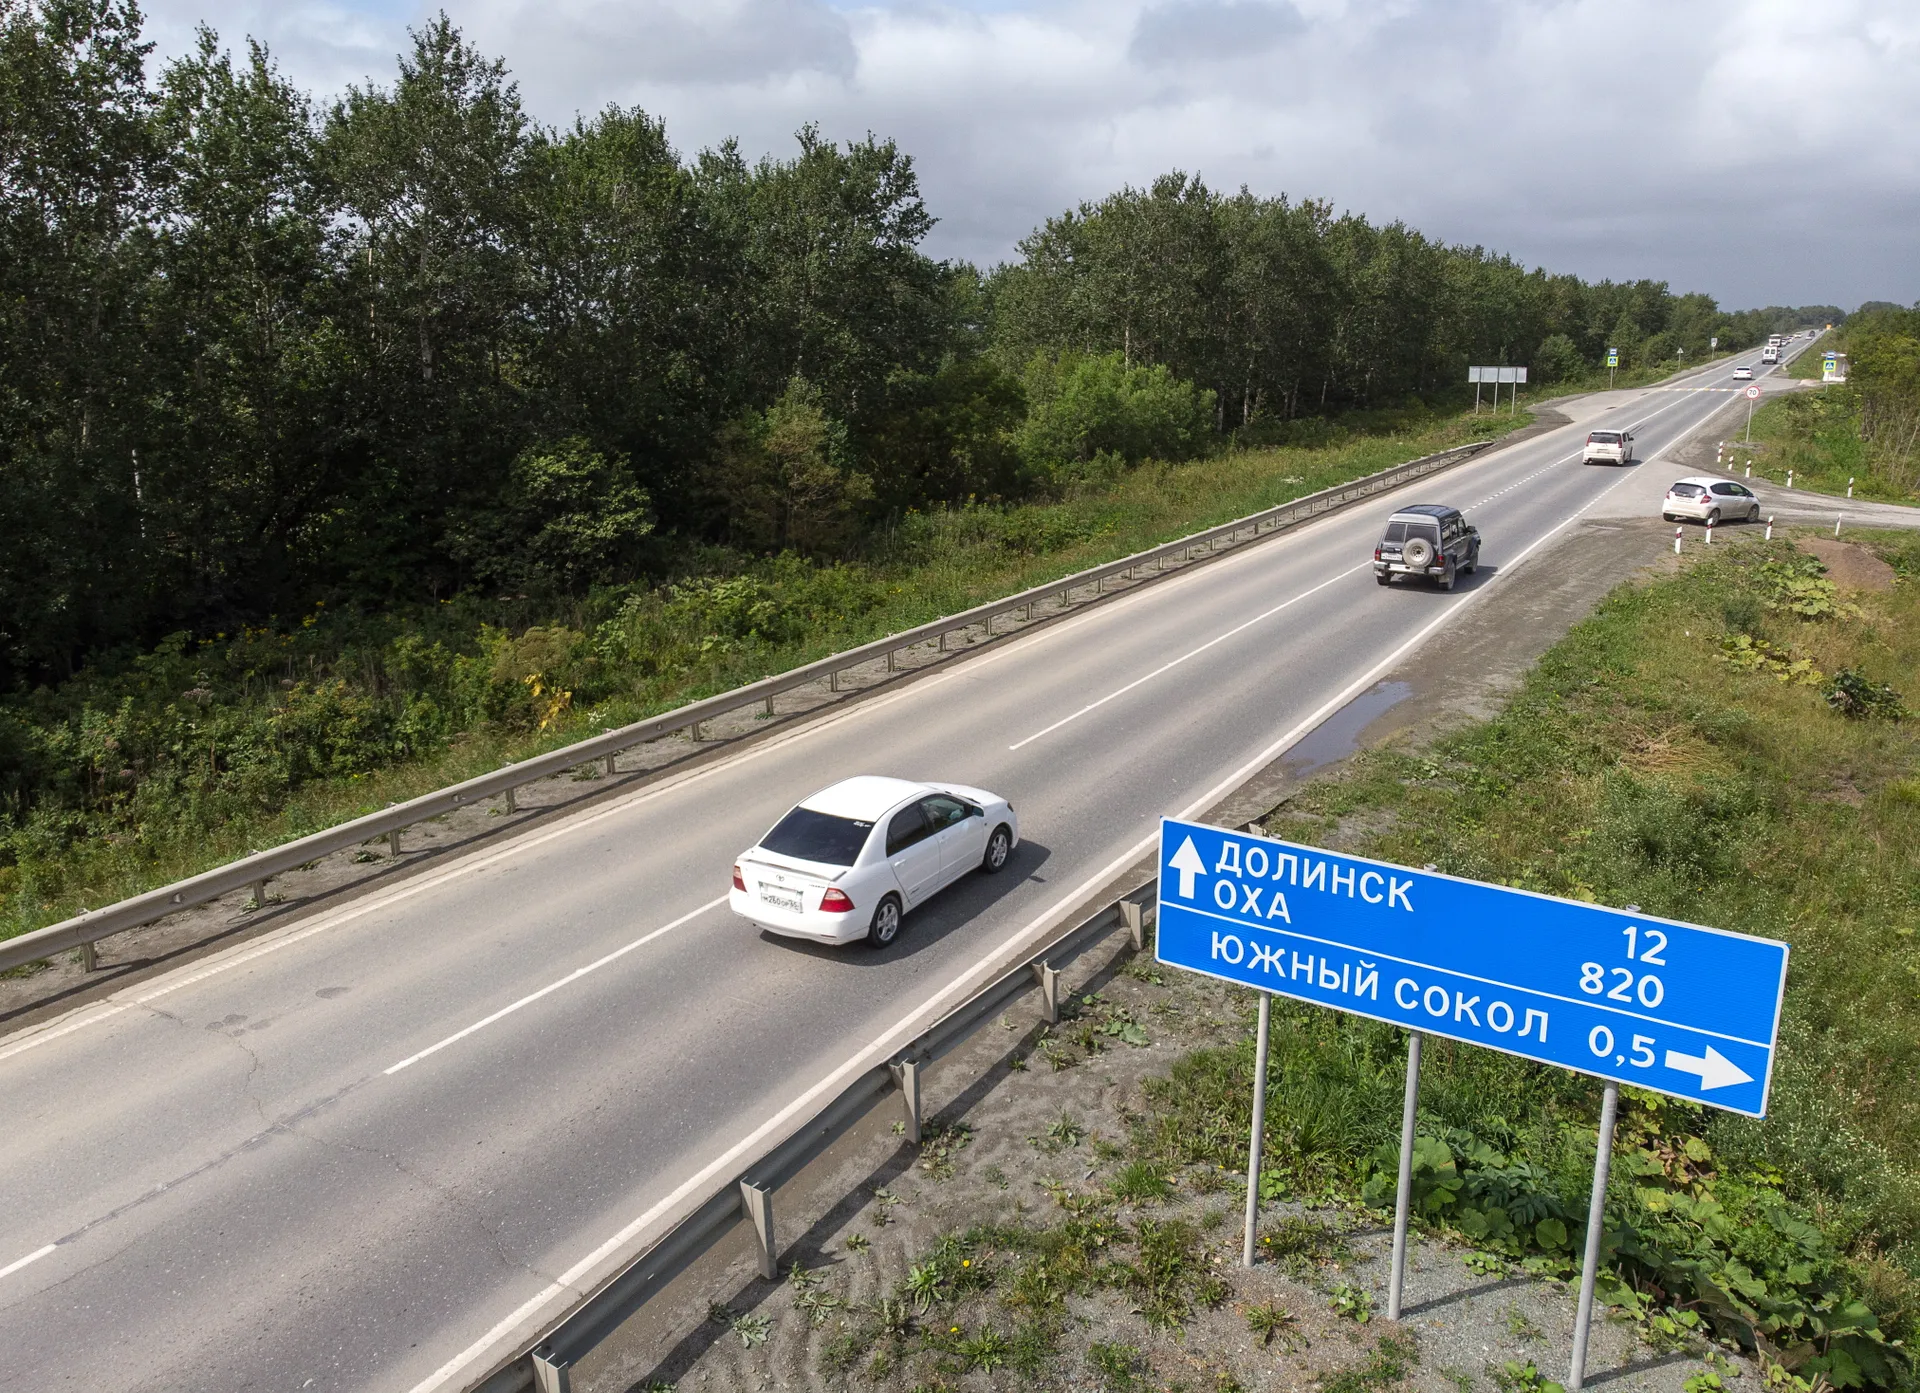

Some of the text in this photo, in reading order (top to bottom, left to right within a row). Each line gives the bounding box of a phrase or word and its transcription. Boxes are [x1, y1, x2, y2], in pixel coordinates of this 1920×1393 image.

[1213, 879, 1665, 1009] ОХА 820
[1215, 840, 1668, 967] ДОЛИНСК 12
[1211, 931, 1656, 1068] ЮЖНЫЙ СОКОЛ 0,5
